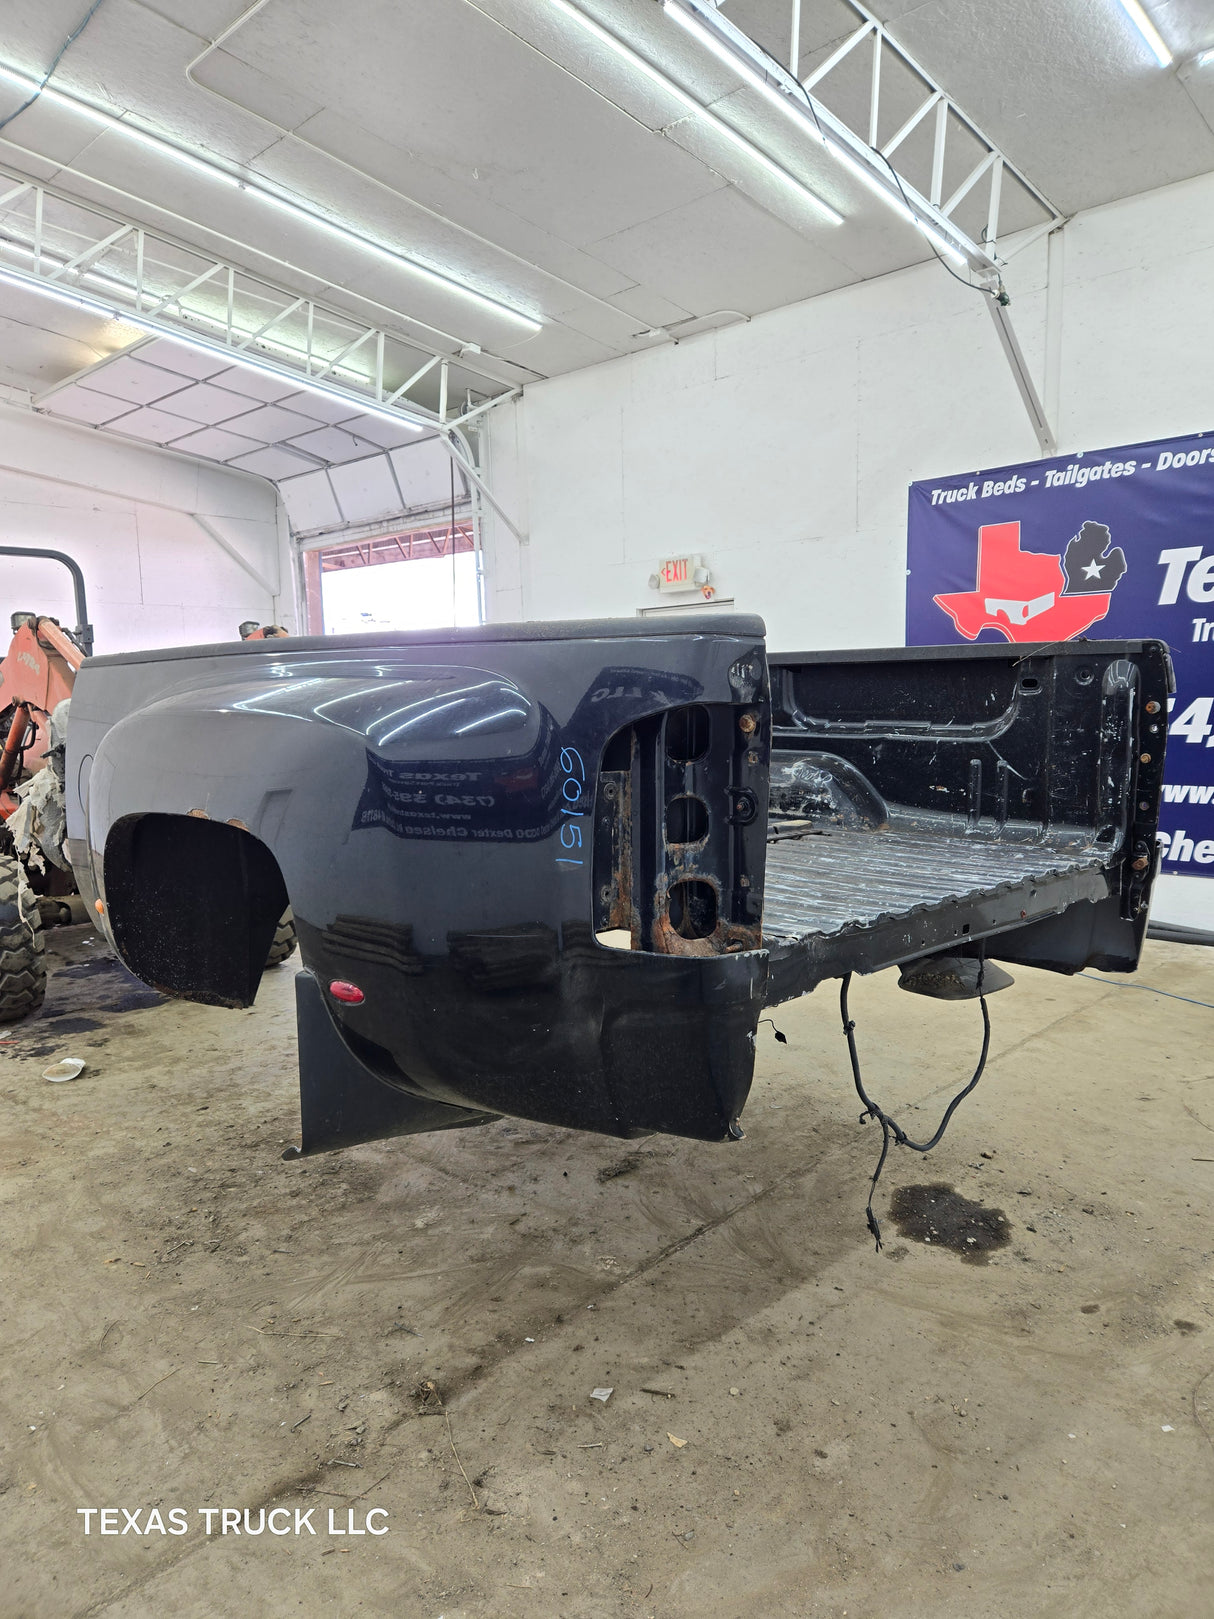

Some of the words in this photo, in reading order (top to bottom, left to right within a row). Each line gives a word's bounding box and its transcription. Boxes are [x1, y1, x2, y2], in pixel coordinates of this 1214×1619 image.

[931, 482, 979, 506] Truck
[981, 475, 1027, 498] Beds
[1044, 460, 1137, 488] Tailgates
[1156, 447, 1214, 471] Doors
[665, 558, 688, 583] EXIT
[1192, 617, 1214, 643] Tr
[555, 746, 586, 865] 60151
